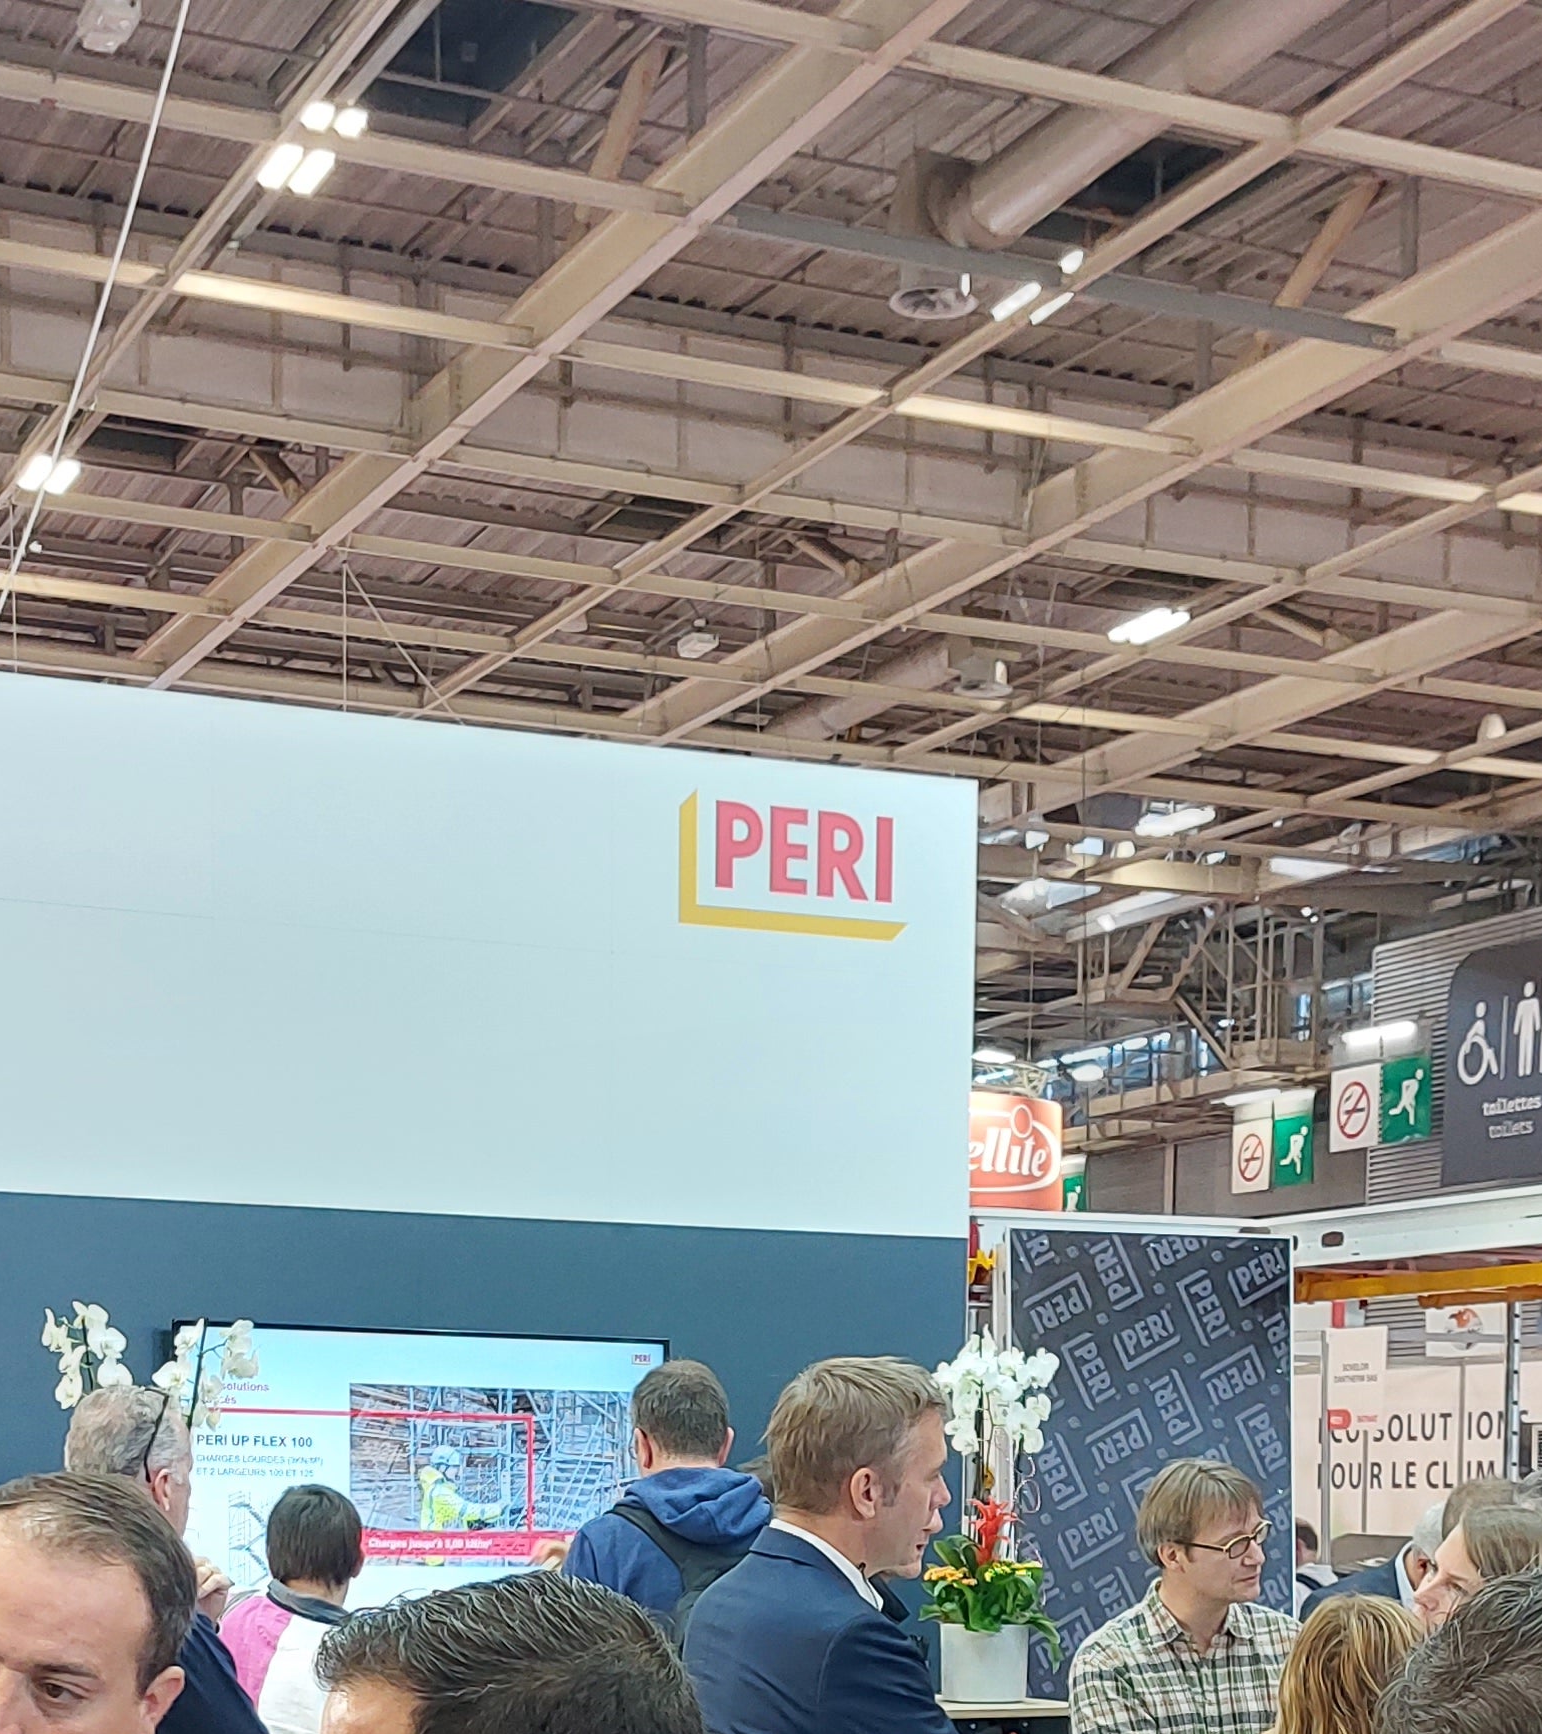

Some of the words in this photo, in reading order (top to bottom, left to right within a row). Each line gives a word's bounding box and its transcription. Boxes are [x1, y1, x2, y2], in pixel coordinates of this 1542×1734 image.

[715, 800, 894, 903] PERI
[1089, 1238, 1132, 1303] PERI
[1234, 1246, 1286, 1293] PERI
[1028, 1286, 1087, 1335] PERI
[1120, 1308, 1176, 1357] PERI
[1189, 1278, 1231, 1341] PERI
[1073, 1341, 1116, 1404] PERI
[1205, 1359, 1260, 1406] PERI
[1147, 1375, 1191, 1439] PERI
[196, 1434, 228, 1446] PERI
[231, 1435, 250, 1447] UP
[253, 1435, 287, 1448] FLEX
[291, 1437, 313, 1448] 100
[1090, 1423, 1146, 1472] PERI
[1249, 1411, 1287, 1473] PERI
[1317, 1462, 1383, 1490] OUR
[1391, 1461, 1418, 1488] LE
[1064, 1508, 1119, 1556] PERI
